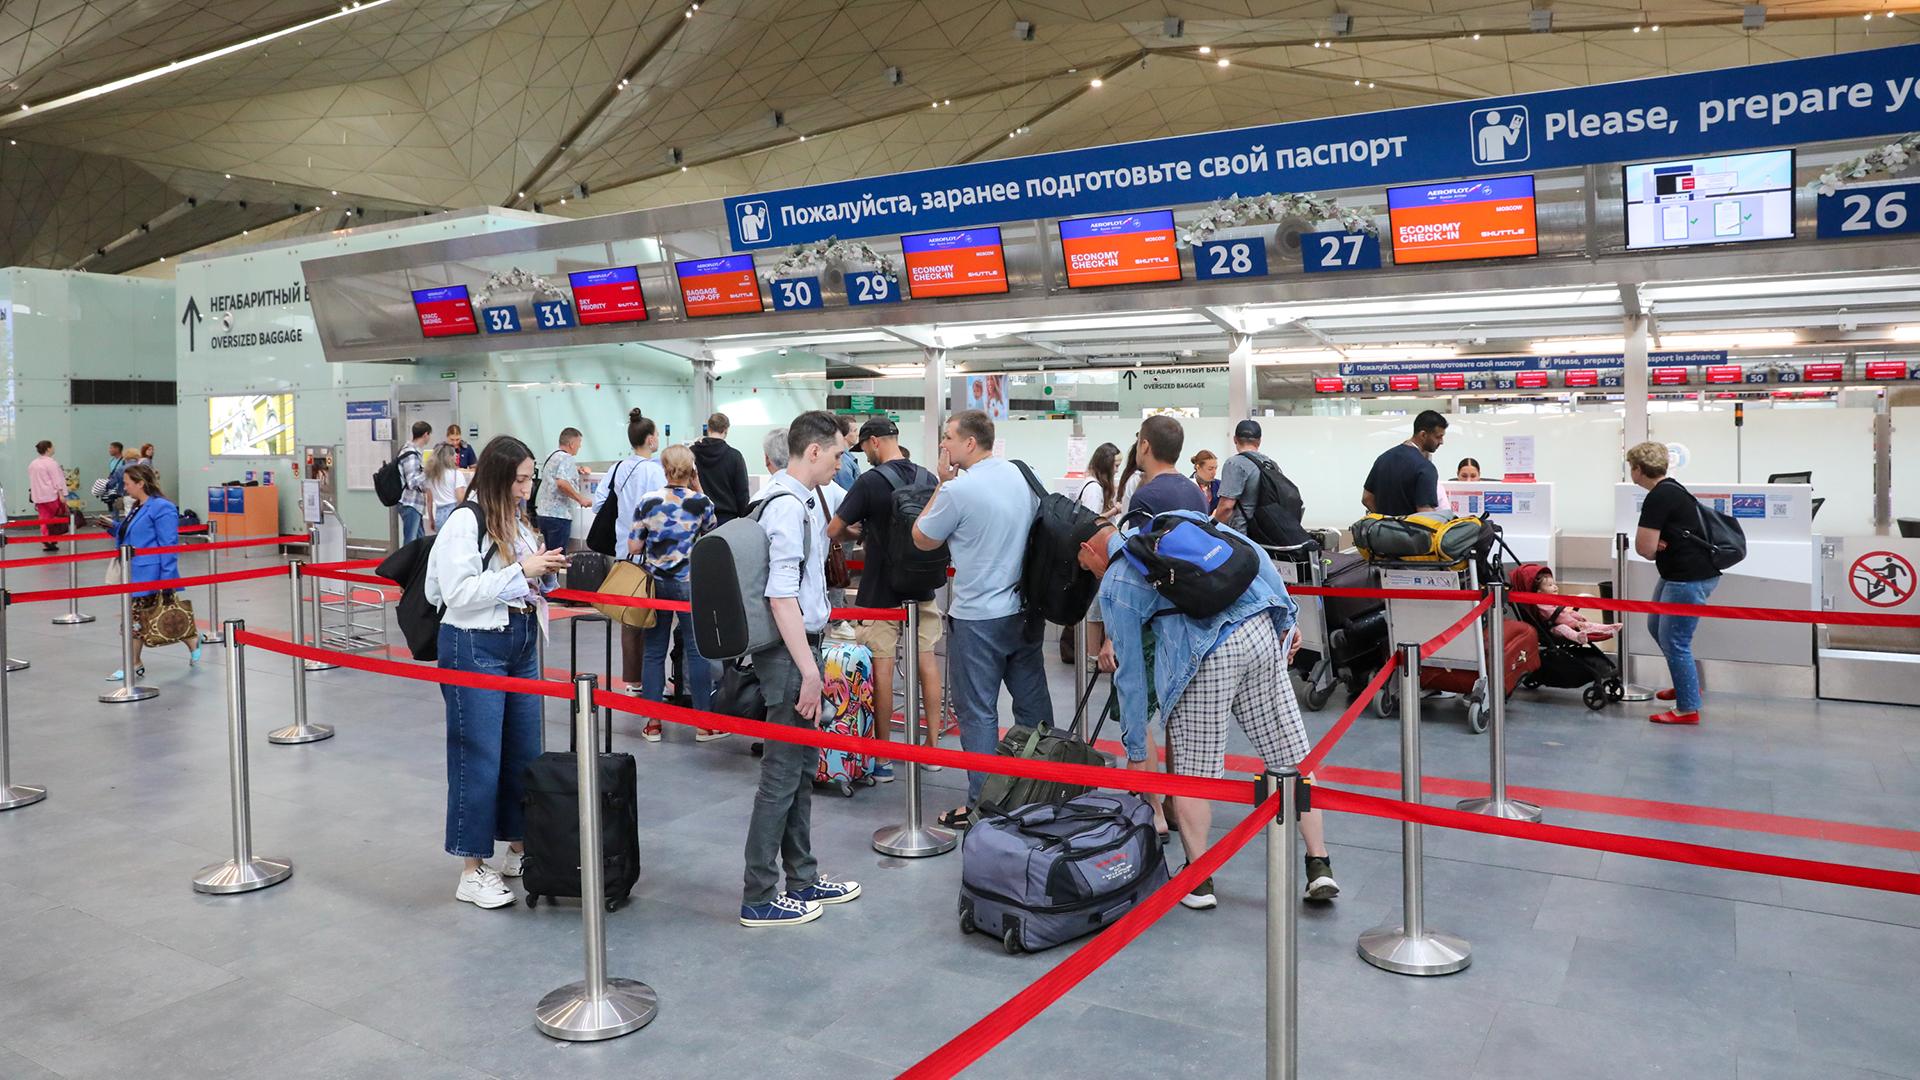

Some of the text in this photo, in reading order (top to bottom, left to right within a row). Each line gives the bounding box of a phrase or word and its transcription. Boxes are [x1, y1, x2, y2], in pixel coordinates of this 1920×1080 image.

[1545, 76, 1920, 141] Please, prepare y
[780, 136, 1408, 227] Пожалуйста, заранее подготовьте свой паспорт
[1427, 187, 1470, 196] AEROFLOT
[1496, 204, 1523, 212] MOSCOW
[1841, 191, 1907, 231] 26
[1399, 222, 1461, 235] ECONOMY
[1481, 228, 1526, 238] SHUTTLE
[1400, 231, 1460, 243] CHECK-IN
[1071, 251, 1119, 262] ECONOMY
[1320, 235, 1365, 268] 27
[1072, 259, 1119, 269] CHECK-IN
[1135, 257, 1169, 265] SHUTTLE
[1209, 243, 1252, 275] 28
[912, 264, 954, 275] ECONOMY
[913, 271, 954, 282] CHECK-IN
[686, 287, 718, 296] BAGGAGE
[856, 275, 888, 302] 29
[210, 281, 301, 312] НЕГАБАРИТНЫЙ
[687, 293, 720, 302] DROP-OFF
[780, 281, 812, 308] 30
[489, 309, 514, 331] 32
[541, 304, 567, 327] 31
[211, 329, 303, 349] OVERSIZED BAGGAGE
[1554, 355, 1580, 366] Please,
[1583, 354, 1614, 367] prepare
[1675, 353, 1685, 361] in
[1685, 352, 1721, 361] advance
[1604, 377, 1617, 386] 52
[1750, 374, 1764, 382] 50
[1781, 373, 1796, 382] 49
[1349, 384, 1361, 393] 56
[1374, 382, 1386, 392] 55
[1470, 381, 1483, 390] 54
[1498, 380, 1511, 389] 53
